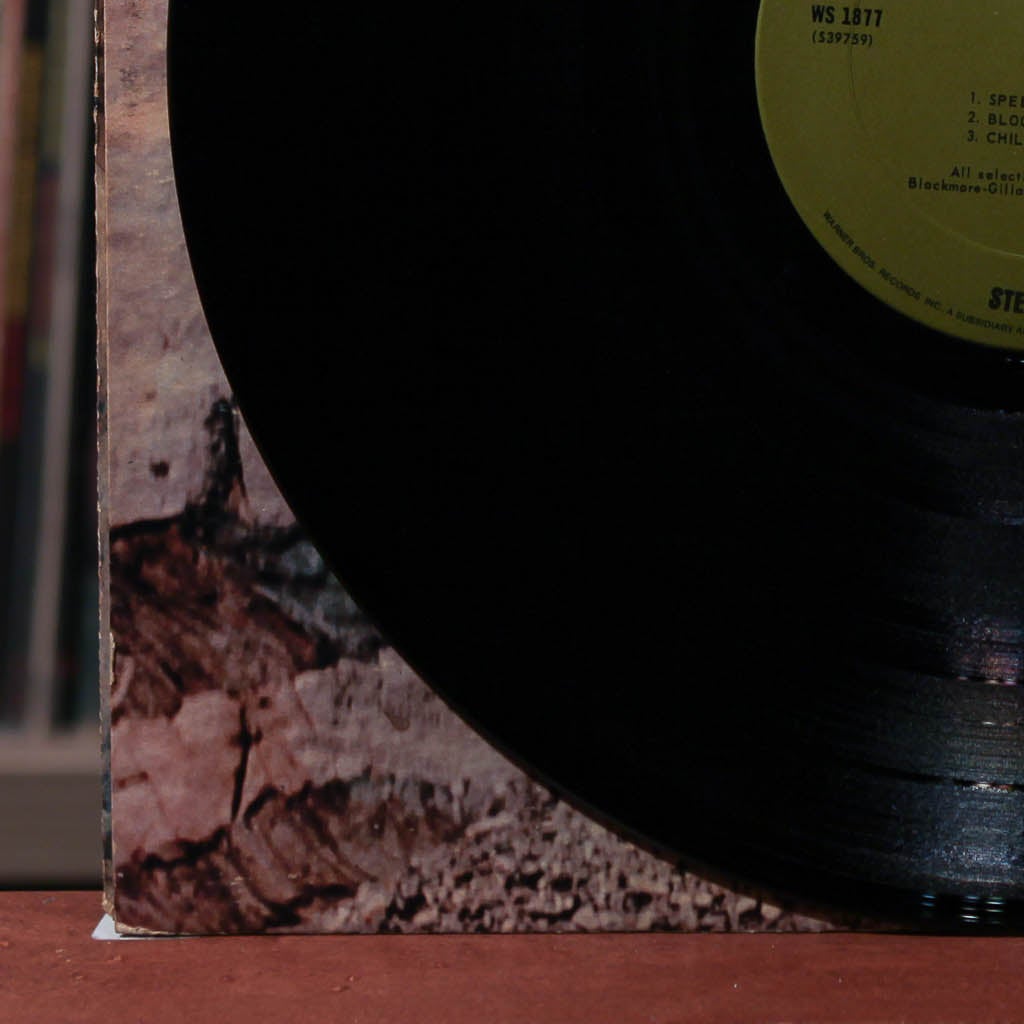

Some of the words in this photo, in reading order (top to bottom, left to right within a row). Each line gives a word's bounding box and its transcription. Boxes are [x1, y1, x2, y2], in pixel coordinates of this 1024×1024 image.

[811, 4, 835, 24] WS
[841, 6, 883, 28] 1877
[970, 91, 981, 105] 1.
[967, 111, 980, 125] 2.
[967, 130, 978, 144] 3.
[951, 165, 971, 179] All
